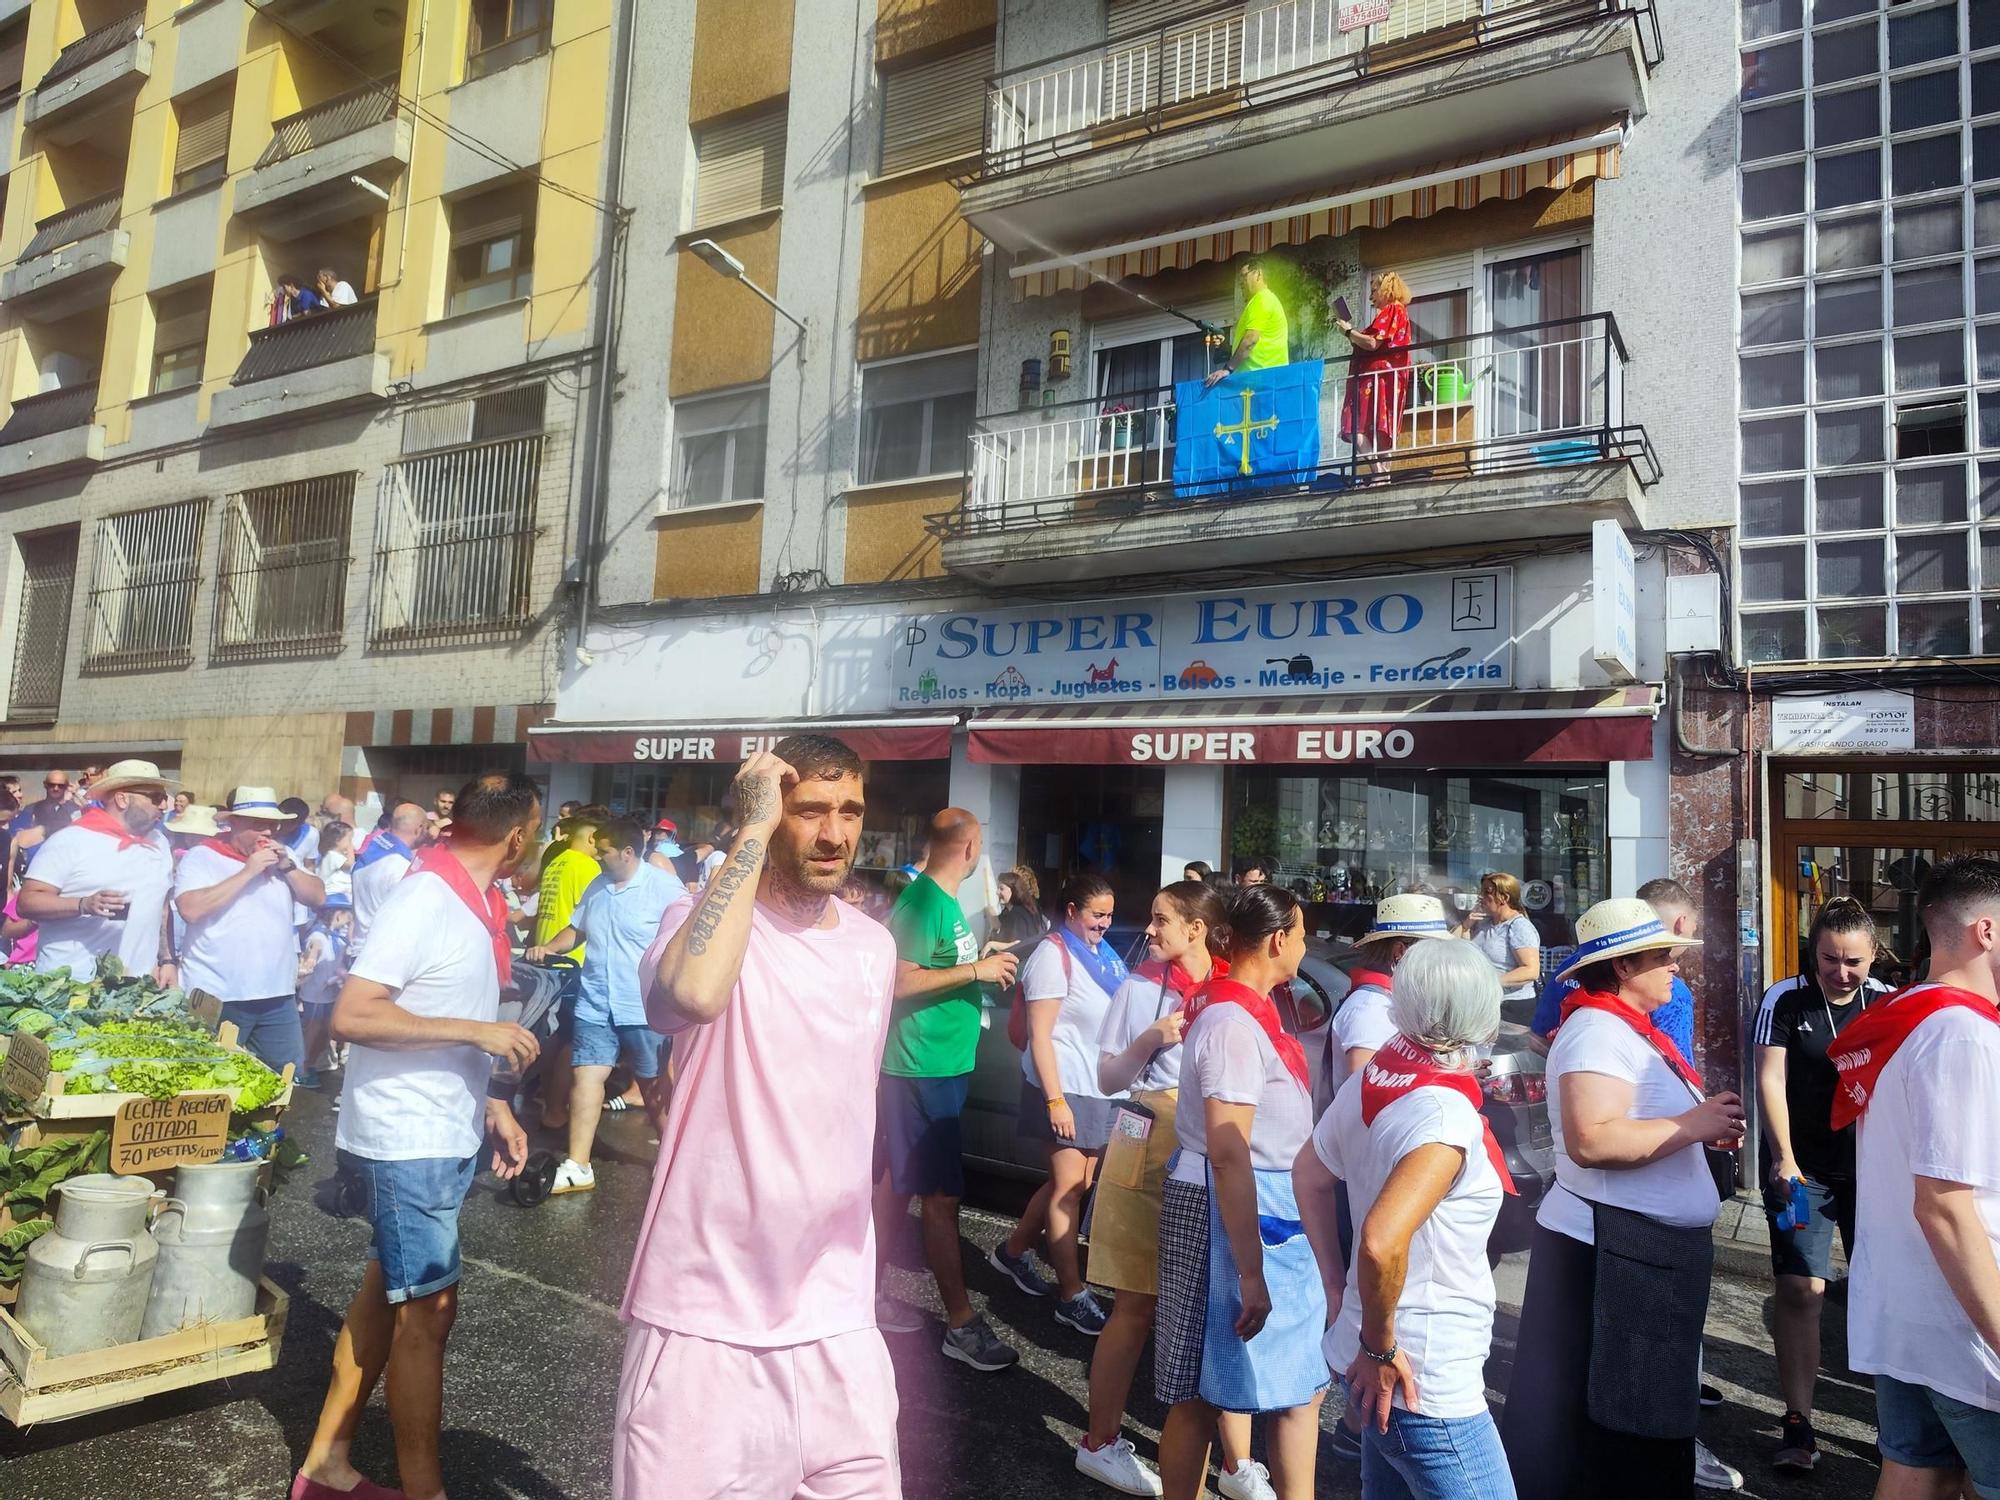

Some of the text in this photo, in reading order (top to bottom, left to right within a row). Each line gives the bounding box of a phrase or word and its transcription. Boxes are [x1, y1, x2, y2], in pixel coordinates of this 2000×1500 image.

[899, 684, 968, 704] Regalos
[985, 683, 1032, 701] Ropa
[1050, 677, 1143, 700] Juguetes
[1163, 671, 1236, 691] Bolsos
[1259, 668, 1345, 689] Menaje
[1369, 660, 1502, 683] Ferretería
[1823, 700, 1862, 708] INSTALAN
[633, 737, 716, 761] SUPER
[1130, 727, 1415, 761] SUPER EURO
[1798, 740, 1889, 749] GASIFICANDO GRADO
[124, 1099, 173, 1120] LECHE
[131, 1119, 198, 1142] CATADA
[120, 1148, 143, 1168] 70
